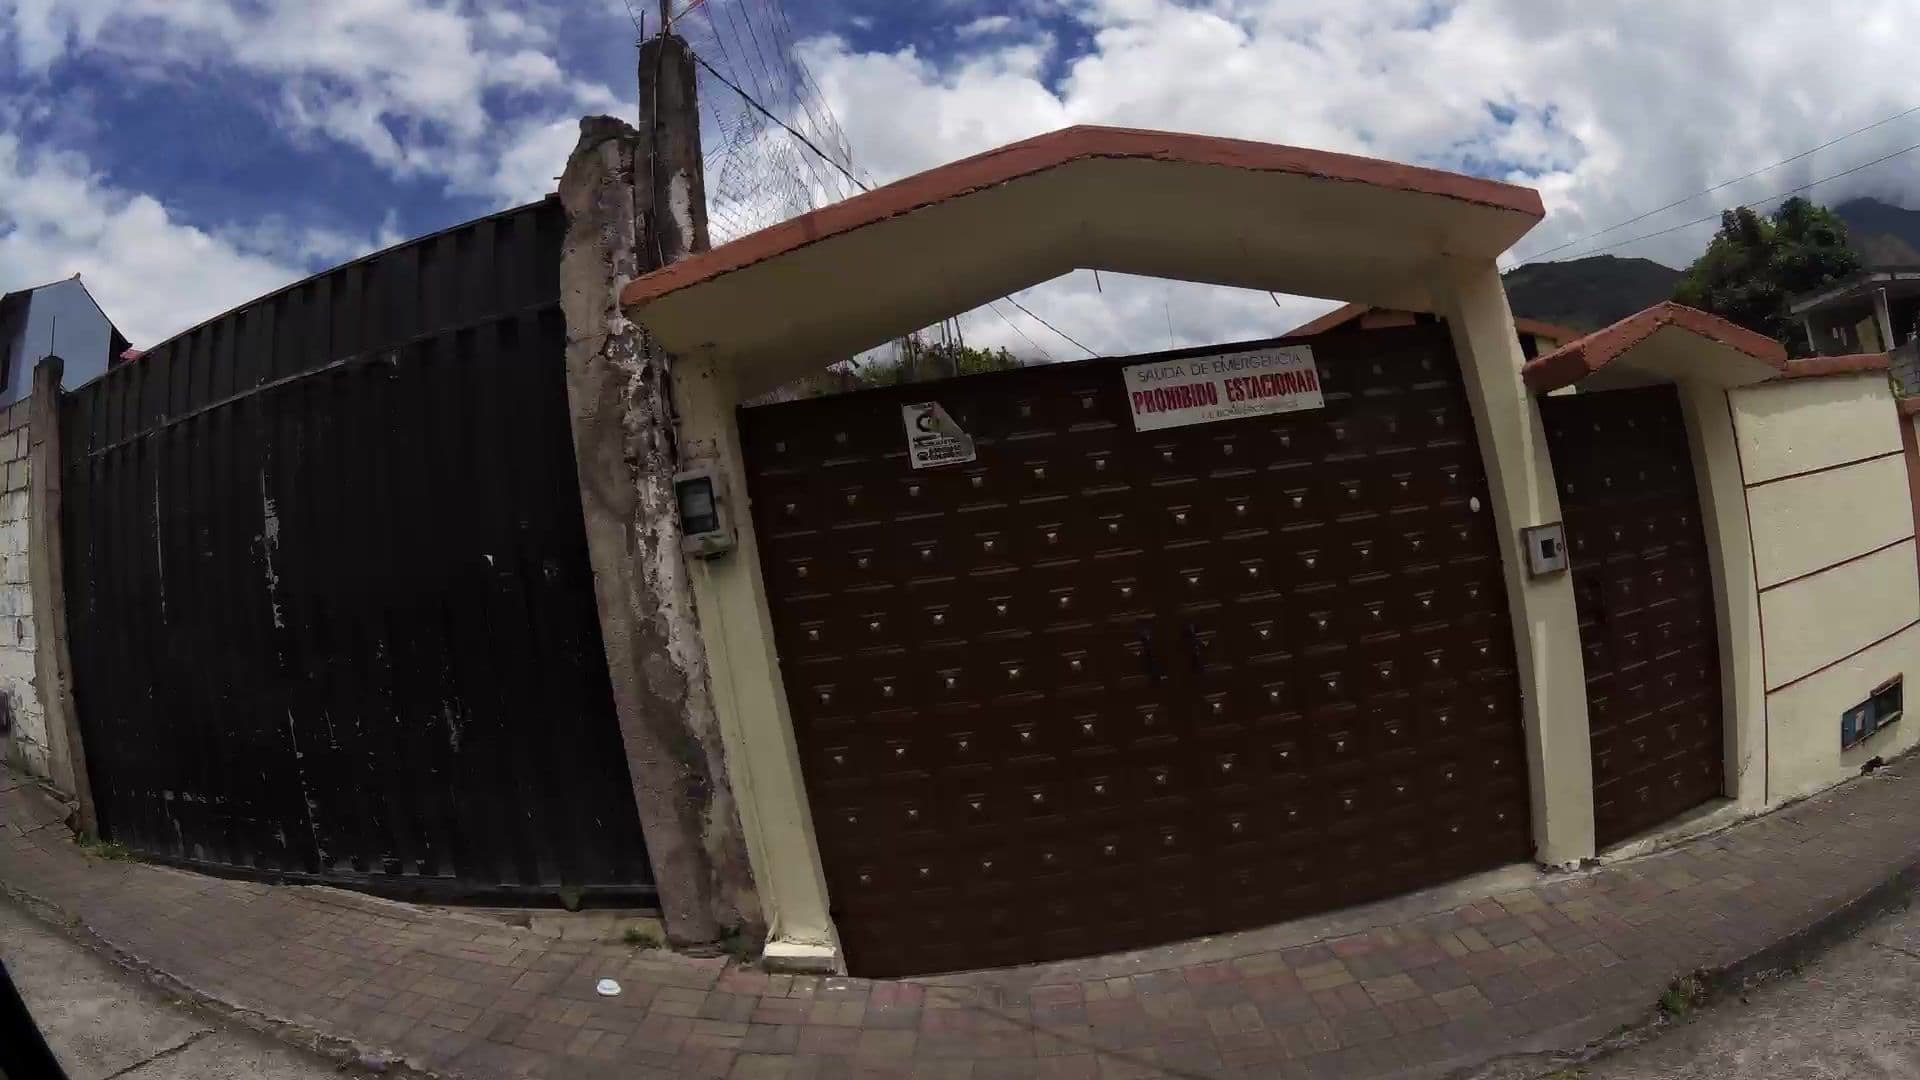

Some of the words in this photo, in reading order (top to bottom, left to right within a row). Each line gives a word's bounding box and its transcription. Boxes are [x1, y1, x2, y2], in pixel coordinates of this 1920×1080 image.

[1137, 365, 1185, 382] SALIDA
[1191, 362, 1209, 376] DE
[1213, 352, 1303, 374] EMERGENCIA
[1132, 381, 1218, 414] PROHIBIDO
[1224, 368, 1318, 402] ESTACIONAR
